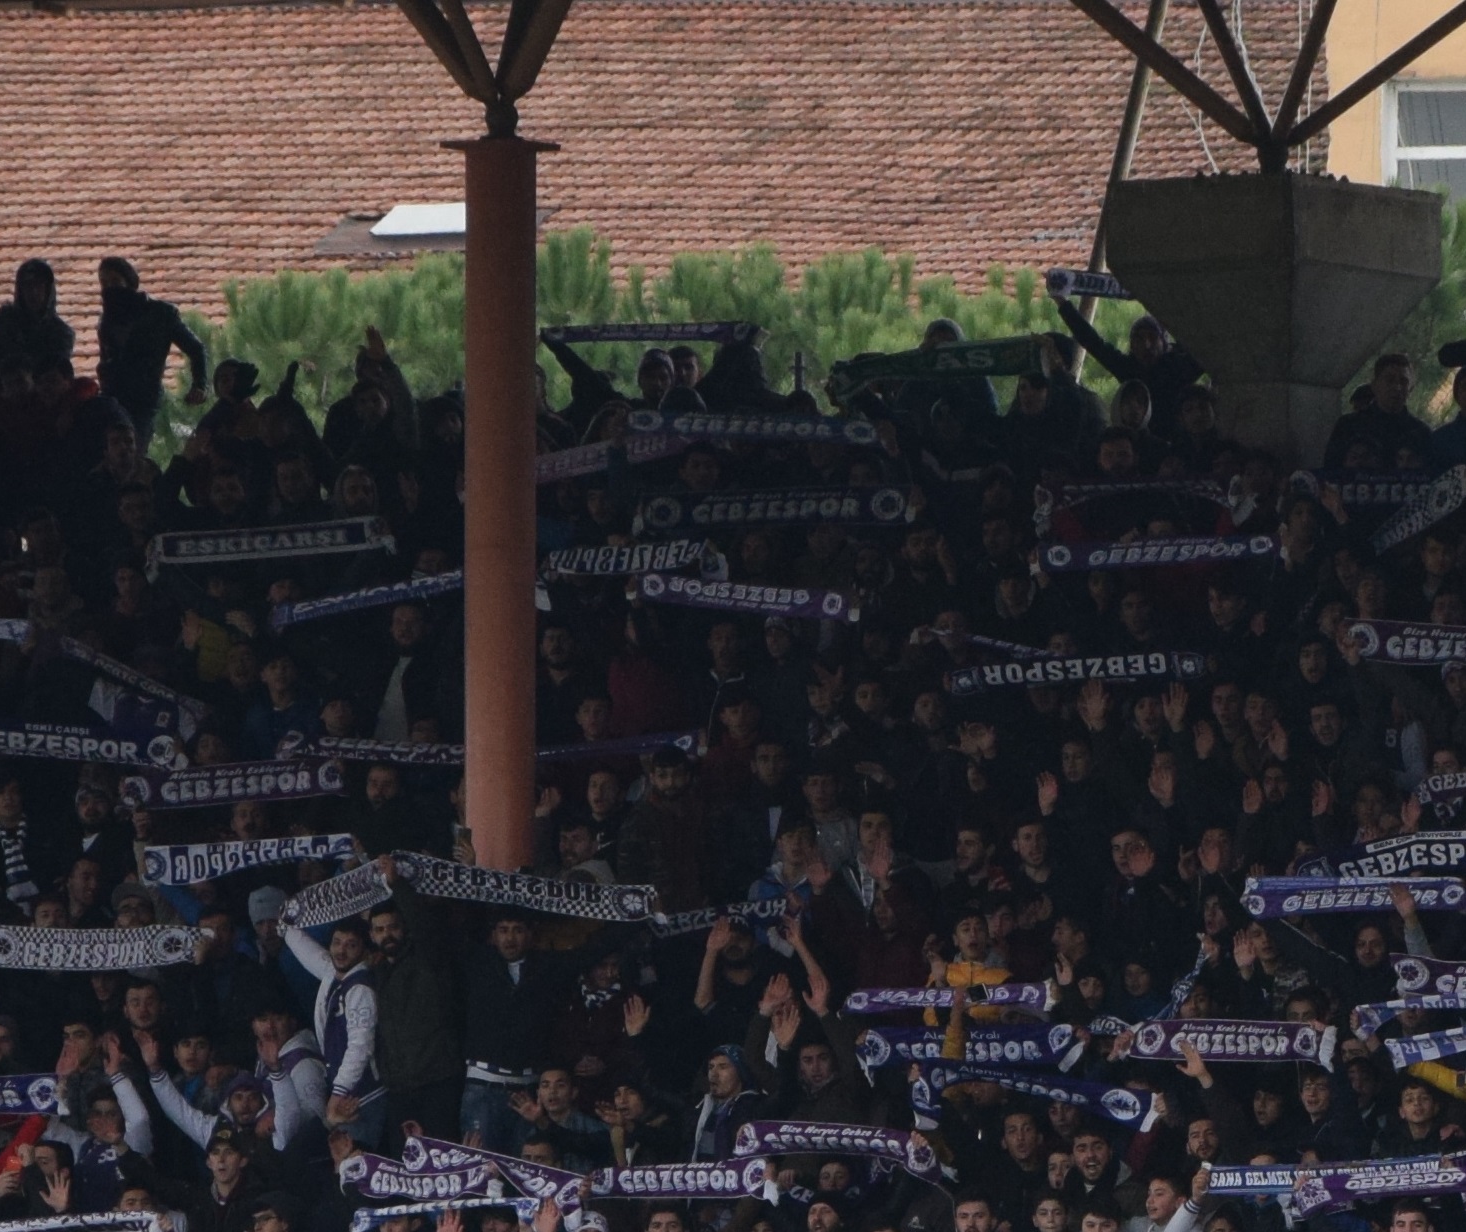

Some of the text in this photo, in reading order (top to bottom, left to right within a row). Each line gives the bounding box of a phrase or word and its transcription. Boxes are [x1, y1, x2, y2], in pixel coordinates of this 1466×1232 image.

[691, 498, 860, 522] GEBZESPOR
[668, 577, 810, 605] GEBZESPOR
[983, 652, 1167, 684] GEBZESPOR
[160, 772, 311, 803] GEBZESPOR
[23, 938, 146, 967] GEBZESPOR
[1170, 1031, 1289, 1055] GEBZESPOR
[618, 1168, 739, 1193] GEBZESPOR
[1210, 1170, 1294, 1190] SANA GELMEK
[1345, 1171, 1466, 1190] GEBZESPOR
